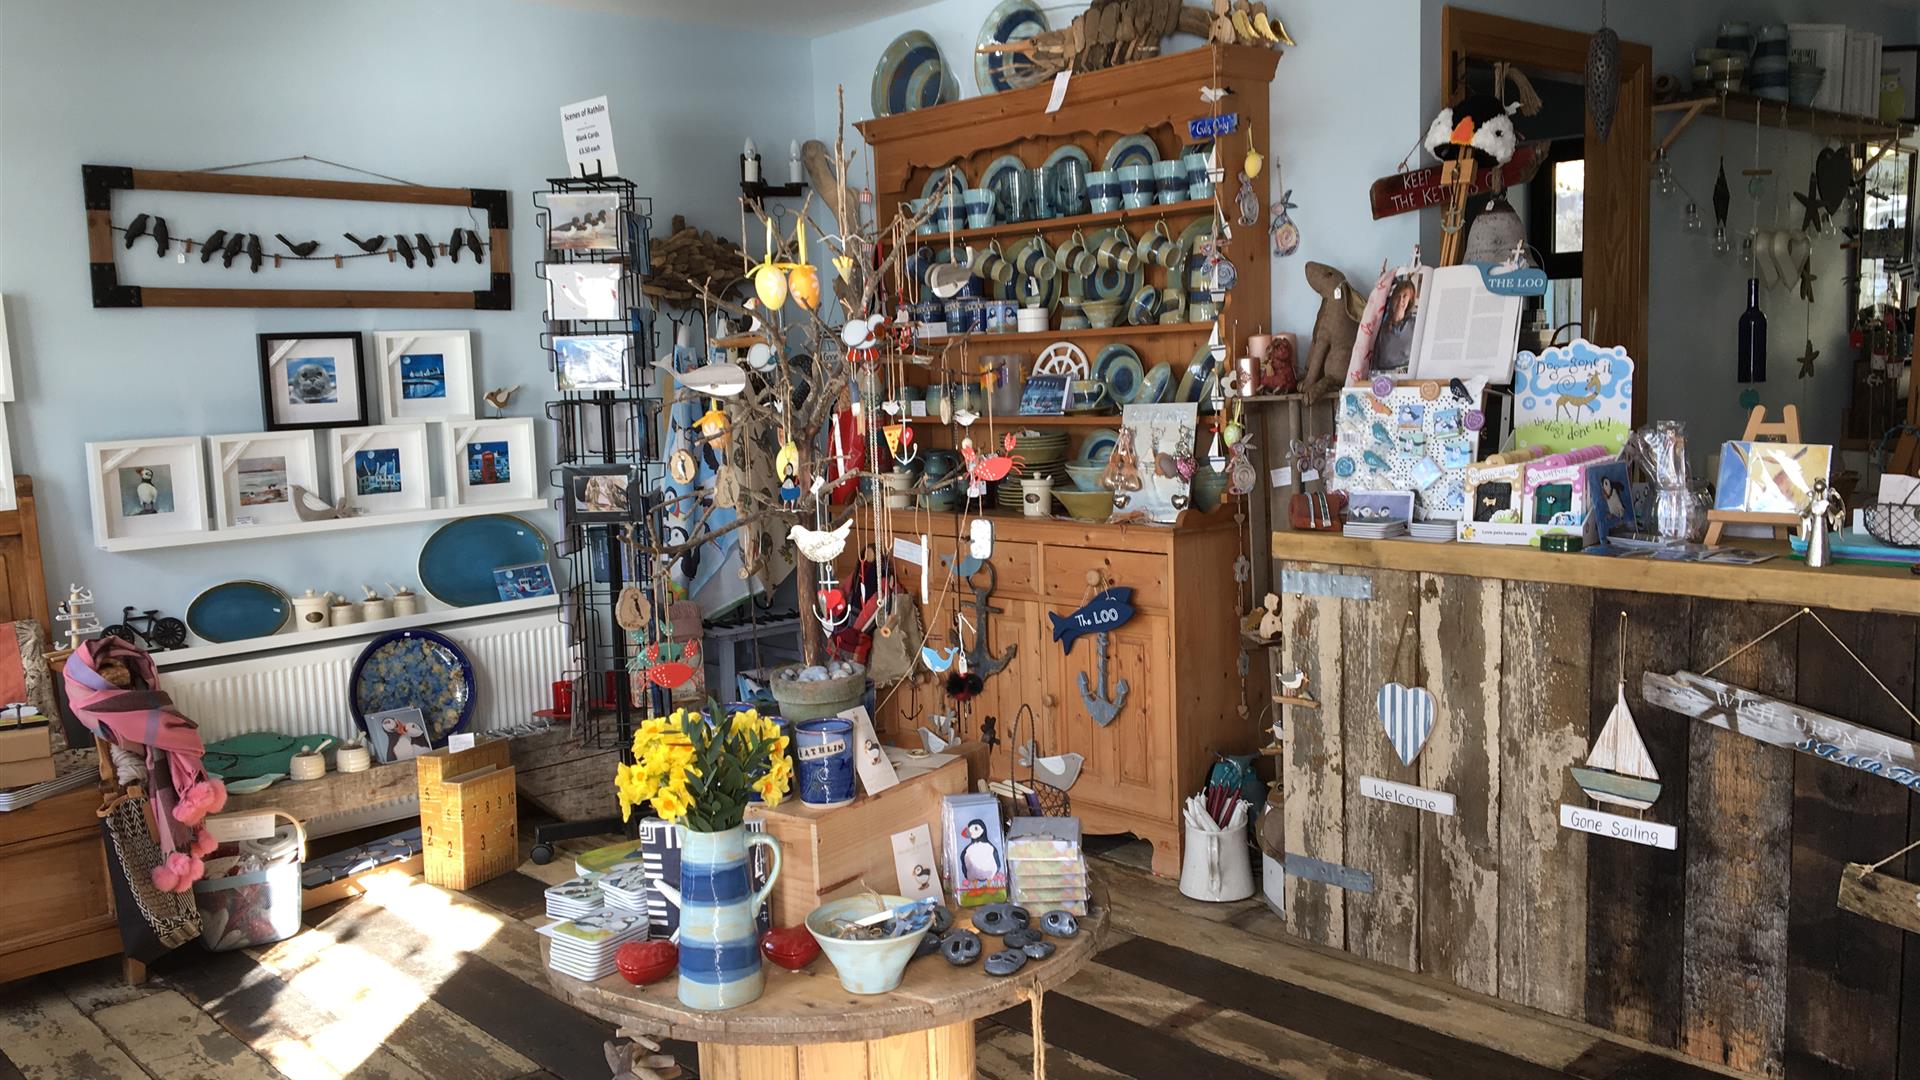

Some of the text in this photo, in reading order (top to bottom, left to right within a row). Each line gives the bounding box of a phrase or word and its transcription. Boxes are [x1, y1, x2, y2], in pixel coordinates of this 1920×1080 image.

[564, 104, 605, 121] Scenes of Rathlin
[576, 131, 600, 142] Blank Cards
[1391, 194, 1416, 212] THE
[1488, 278, 1544, 289] THE LOO
[1603, 363, 1613, 375] it
[1534, 416, 1545, 426] the
[1594, 417, 1612, 432] it!
[1075, 608, 1119, 627] The LOO
[1715, 691, 1893, 763] WISH UPON A
[508, 791, 515, 805] 10
[1373, 784, 1437, 811] Welcome
[1571, 811, 1659, 845] Gone Sailing
